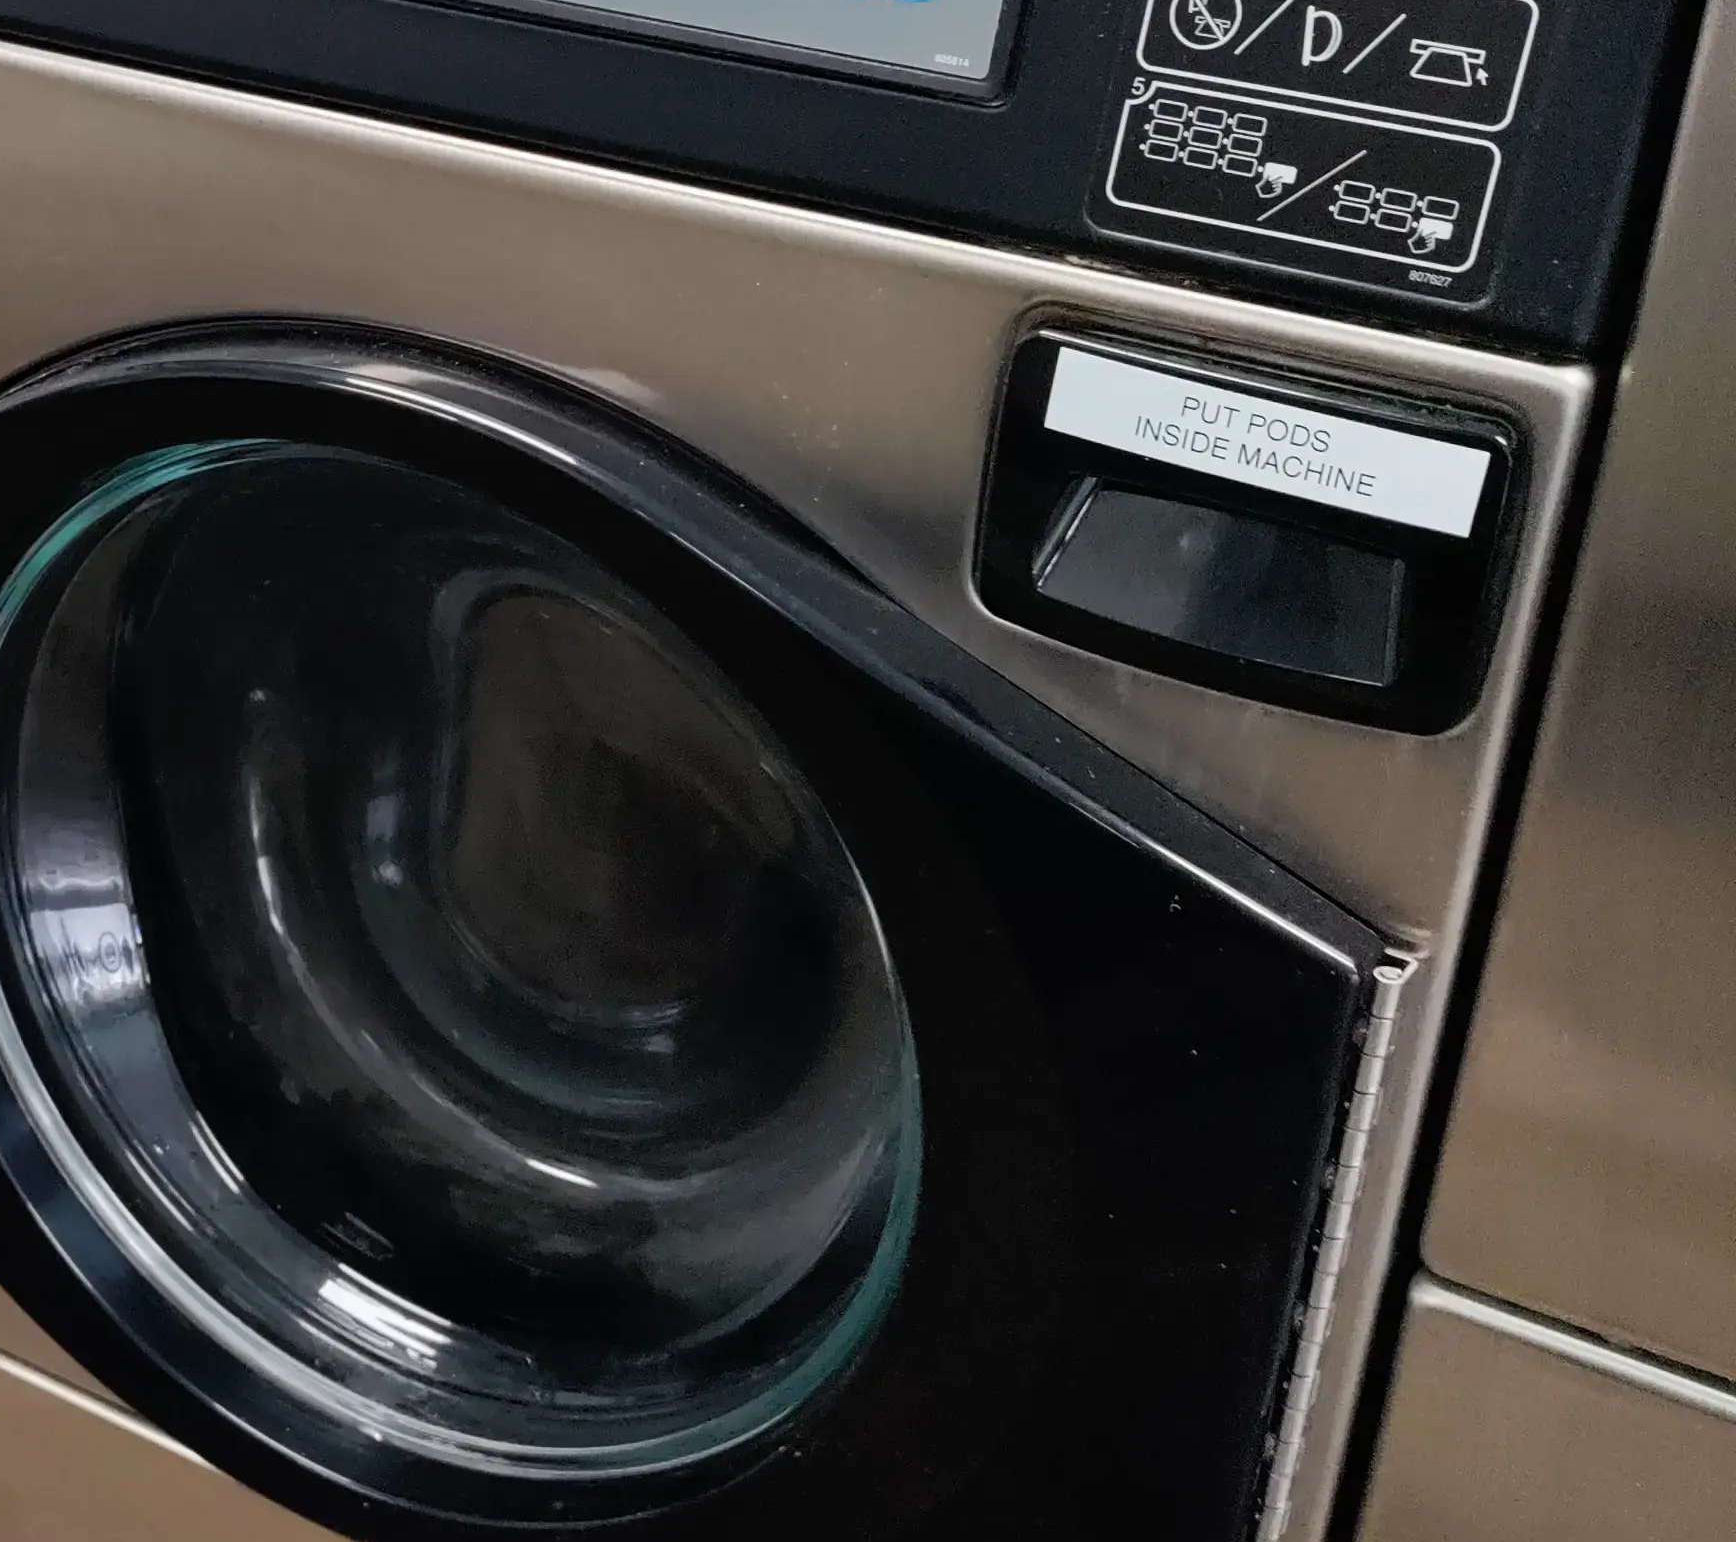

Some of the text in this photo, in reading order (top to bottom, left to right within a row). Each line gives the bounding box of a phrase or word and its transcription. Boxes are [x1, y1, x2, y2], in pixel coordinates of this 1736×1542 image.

[1131, 76, 1146, 96] 5
[1180, 396, 1332, 453] PUT PODS
[1134, 415, 1377, 497] INSIDE MACHINE
